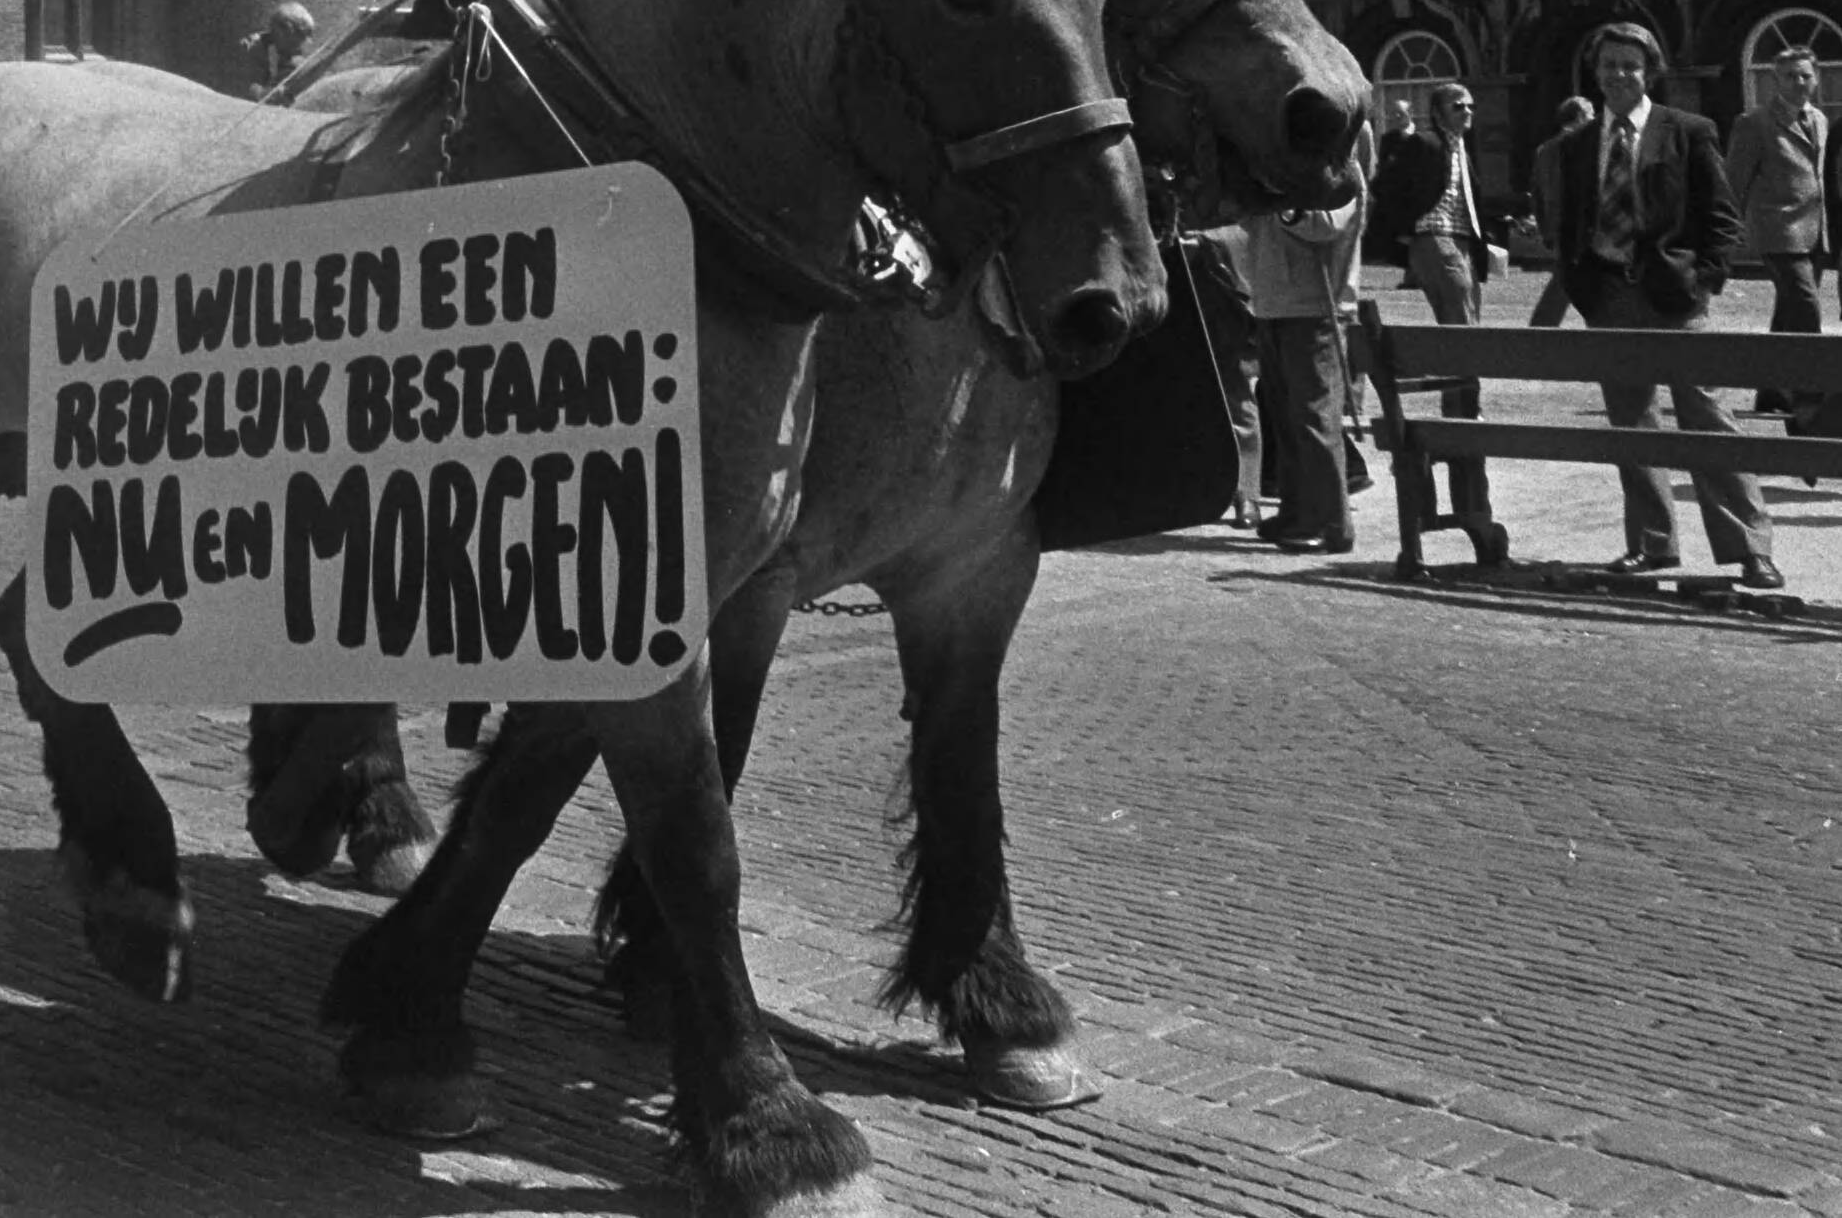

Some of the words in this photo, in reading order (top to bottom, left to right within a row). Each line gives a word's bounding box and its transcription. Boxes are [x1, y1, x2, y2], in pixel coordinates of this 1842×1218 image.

[55, 275, 157, 365] WIJ
[176, 245, 401, 355] WILLEN
[419, 227, 556, 330] EEN
[53, 361, 330, 470] REDELIJK
[44, 474, 188, 610] NU
[284, 427, 687, 667] MORGEN!
